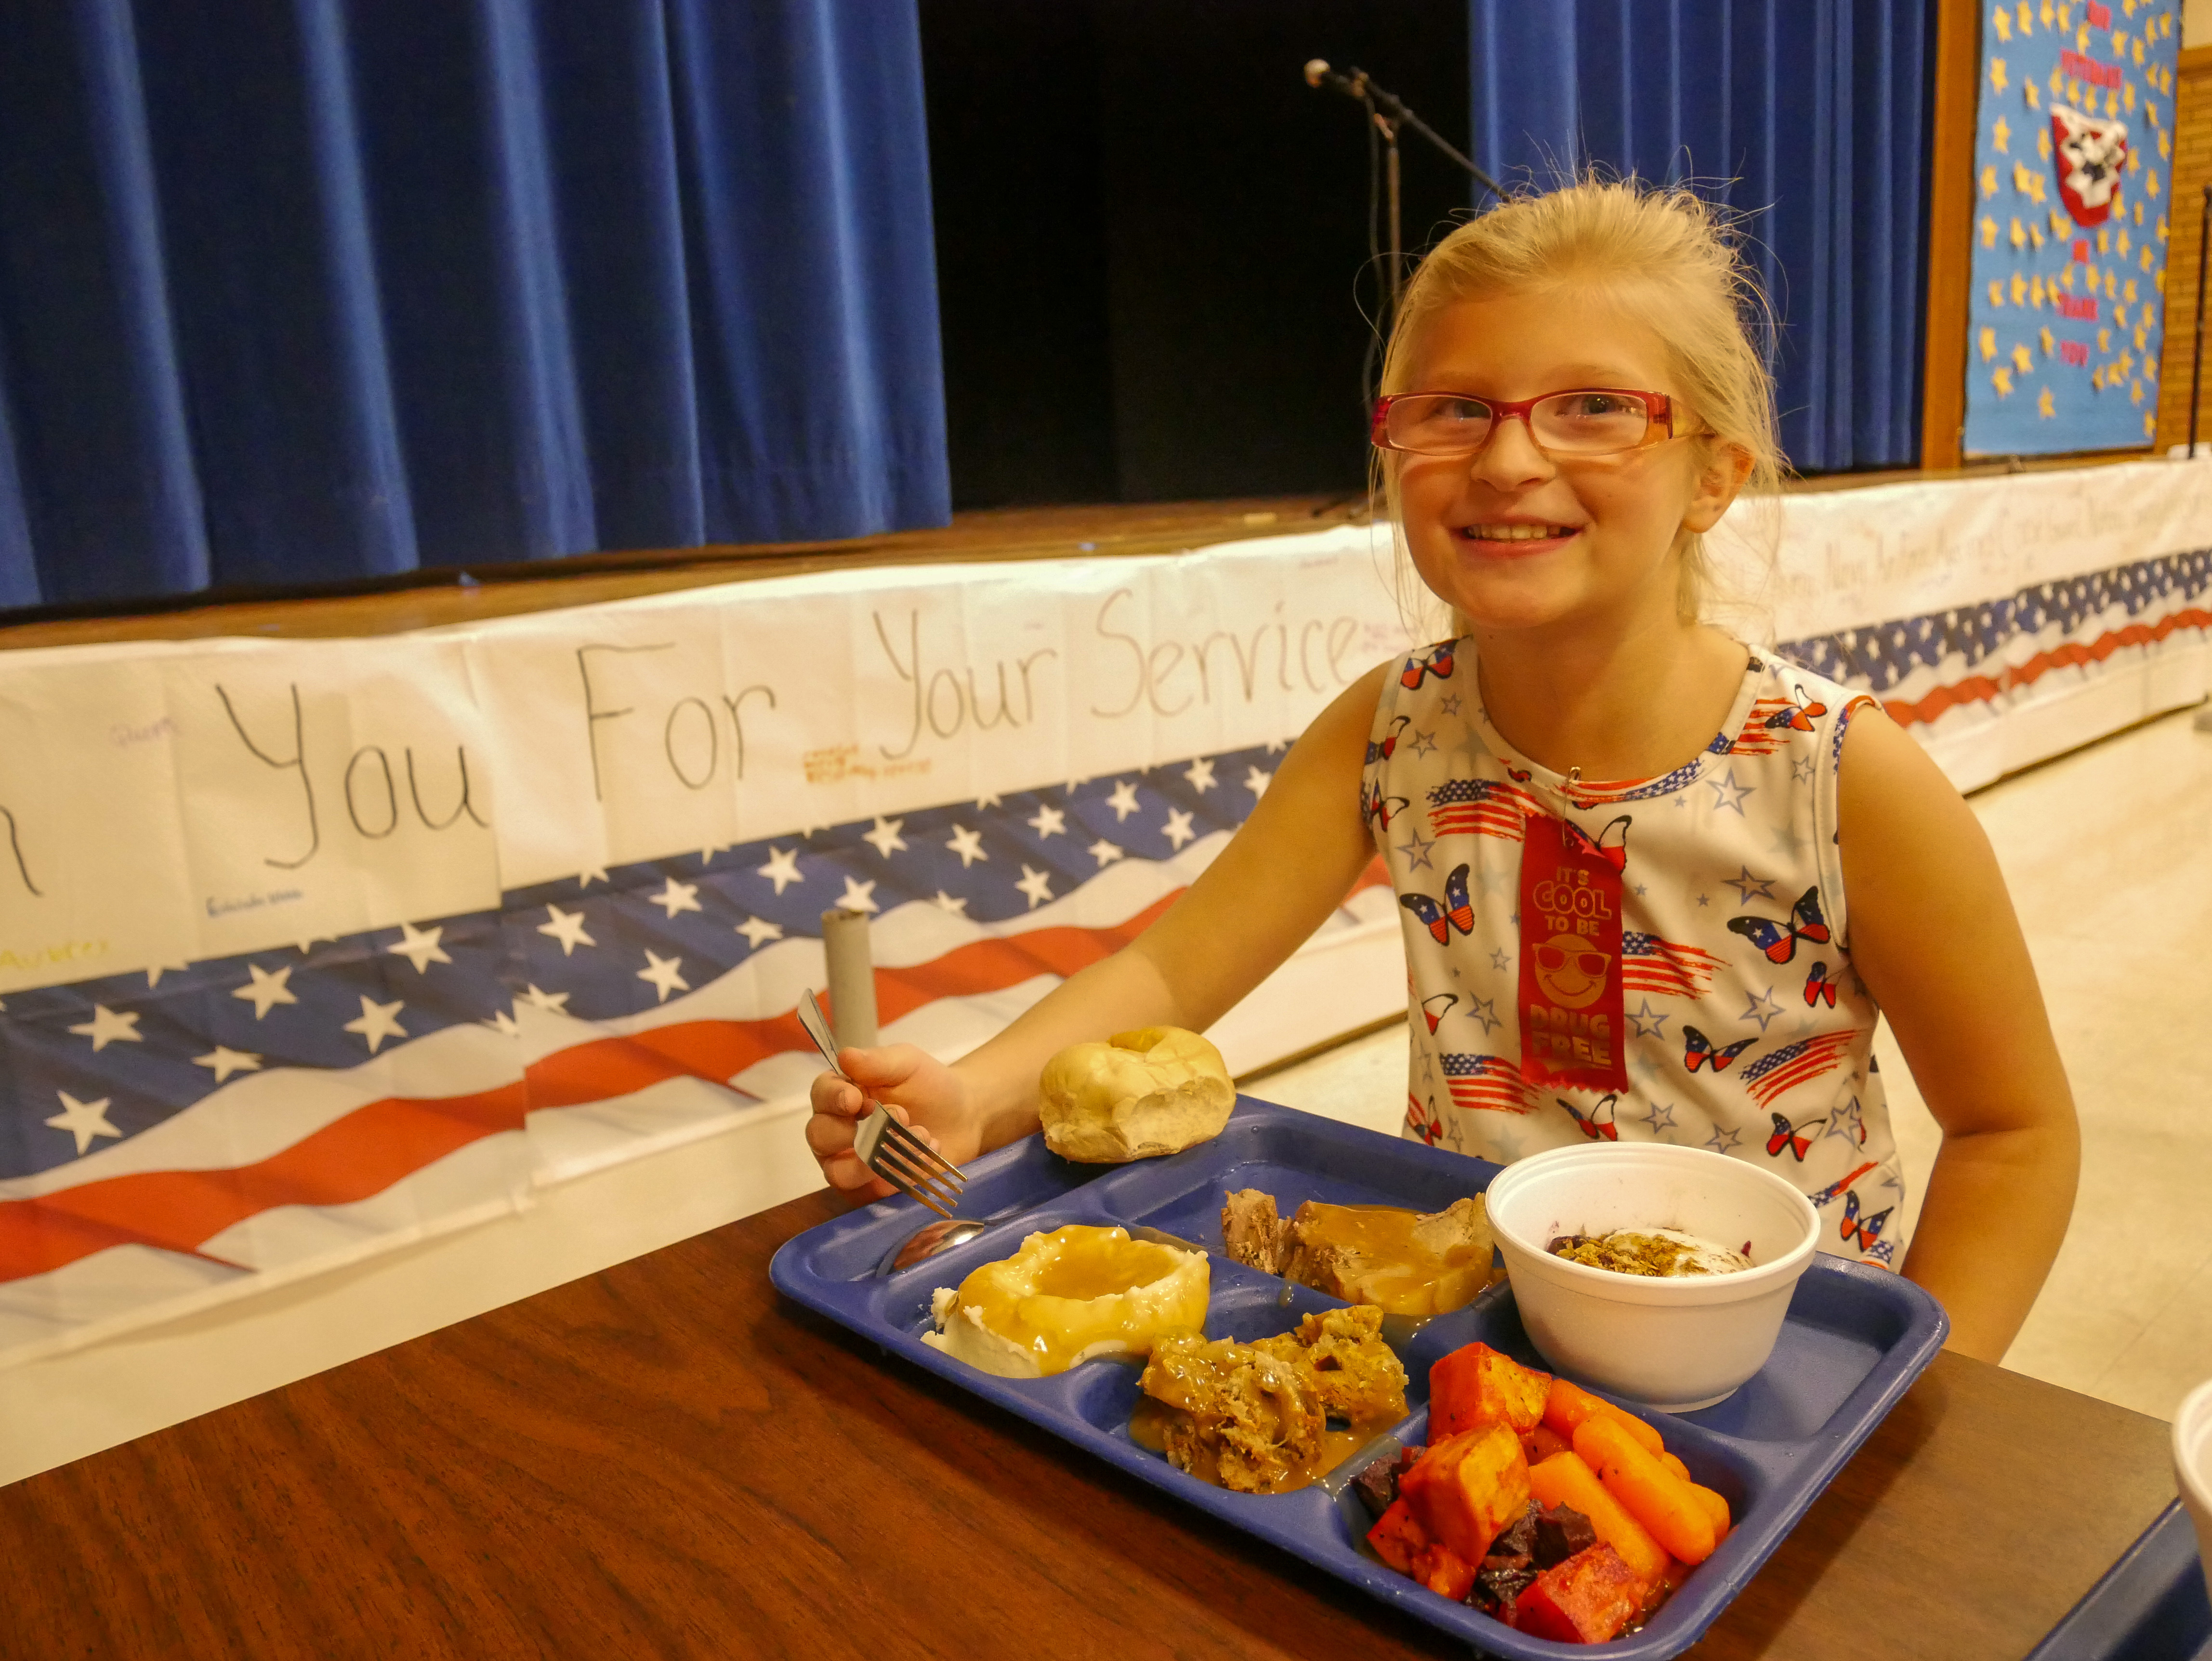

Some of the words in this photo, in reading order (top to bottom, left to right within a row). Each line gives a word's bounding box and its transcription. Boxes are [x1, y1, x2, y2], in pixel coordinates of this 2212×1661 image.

[215, 681, 490, 869] You
[577, 641, 777, 802] For
[872, 608, 1058, 761] Your
[1091, 587, 1360, 719] Service
[1556, 866, 1590, 886] IT'S
[1533, 880, 1612, 920] COOL
[1544, 915, 1569, 932] TO
[1576, 918, 1600, 936] BE
[1529, 1003, 1611, 1039] DRUG
[1531, 1030, 1612, 1066] FREE
